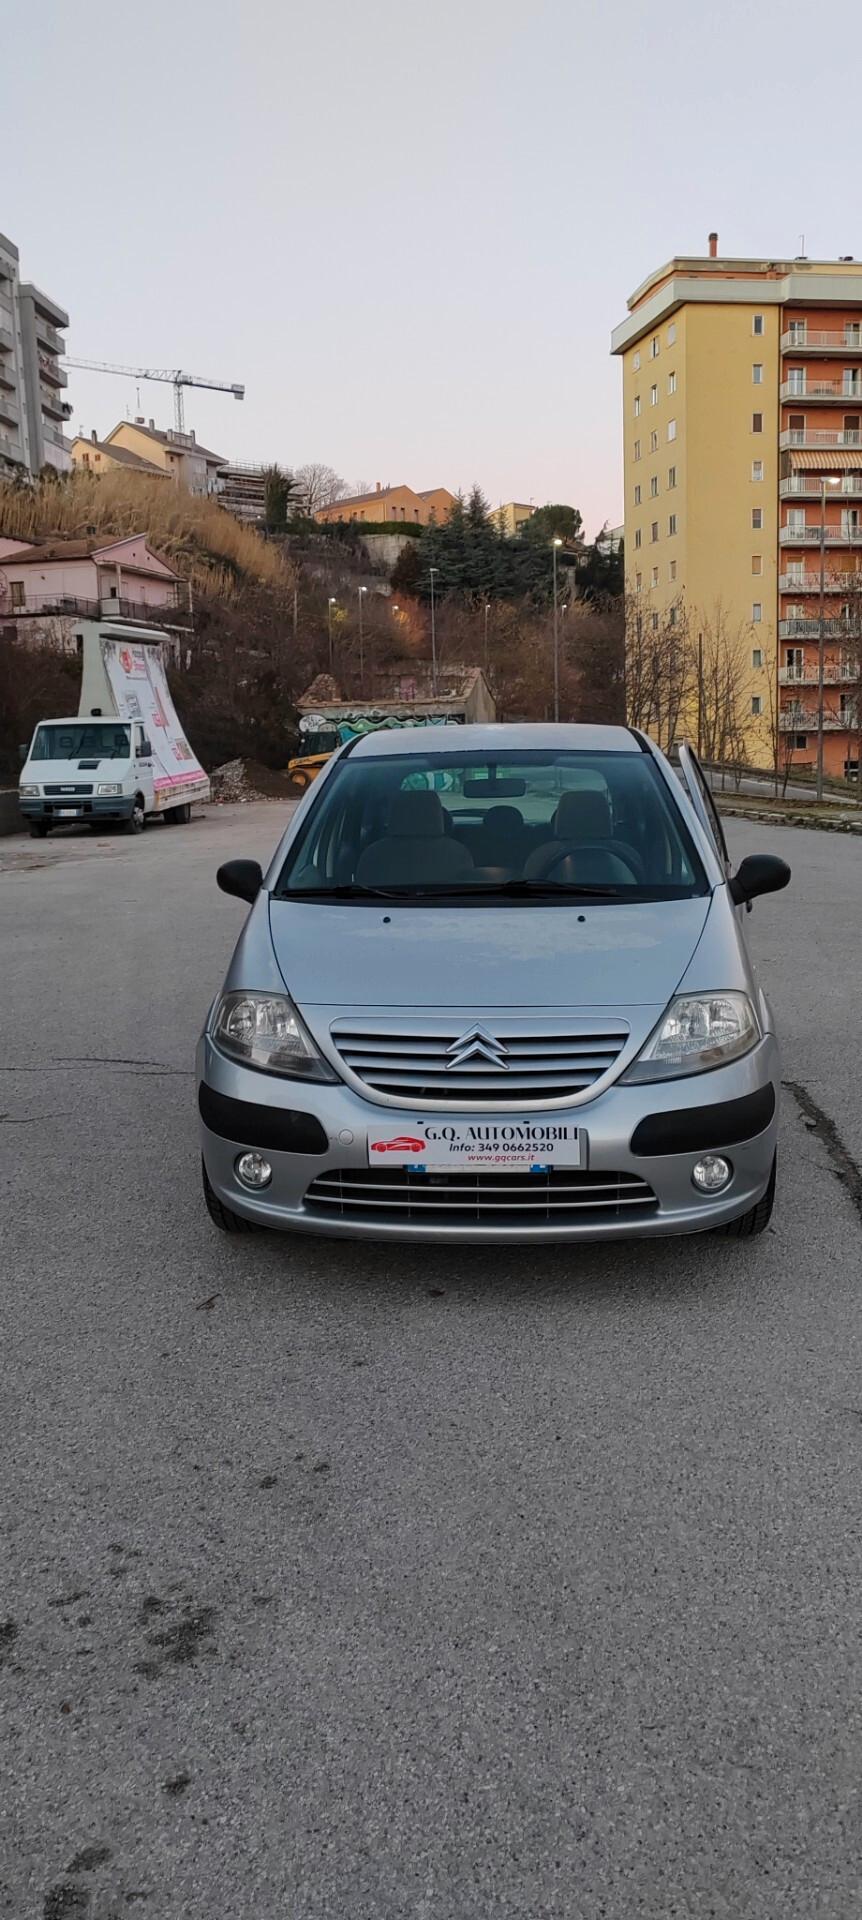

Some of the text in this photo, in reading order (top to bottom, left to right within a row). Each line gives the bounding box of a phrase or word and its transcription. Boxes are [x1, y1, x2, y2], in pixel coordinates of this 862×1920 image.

[424, 1126, 579, 1142] G.Q. AUTOMOBILI
[449, 1143, 554, 1153] Info: 349 0662520
[467, 1153, 535, 1163] www.gqcars.it
